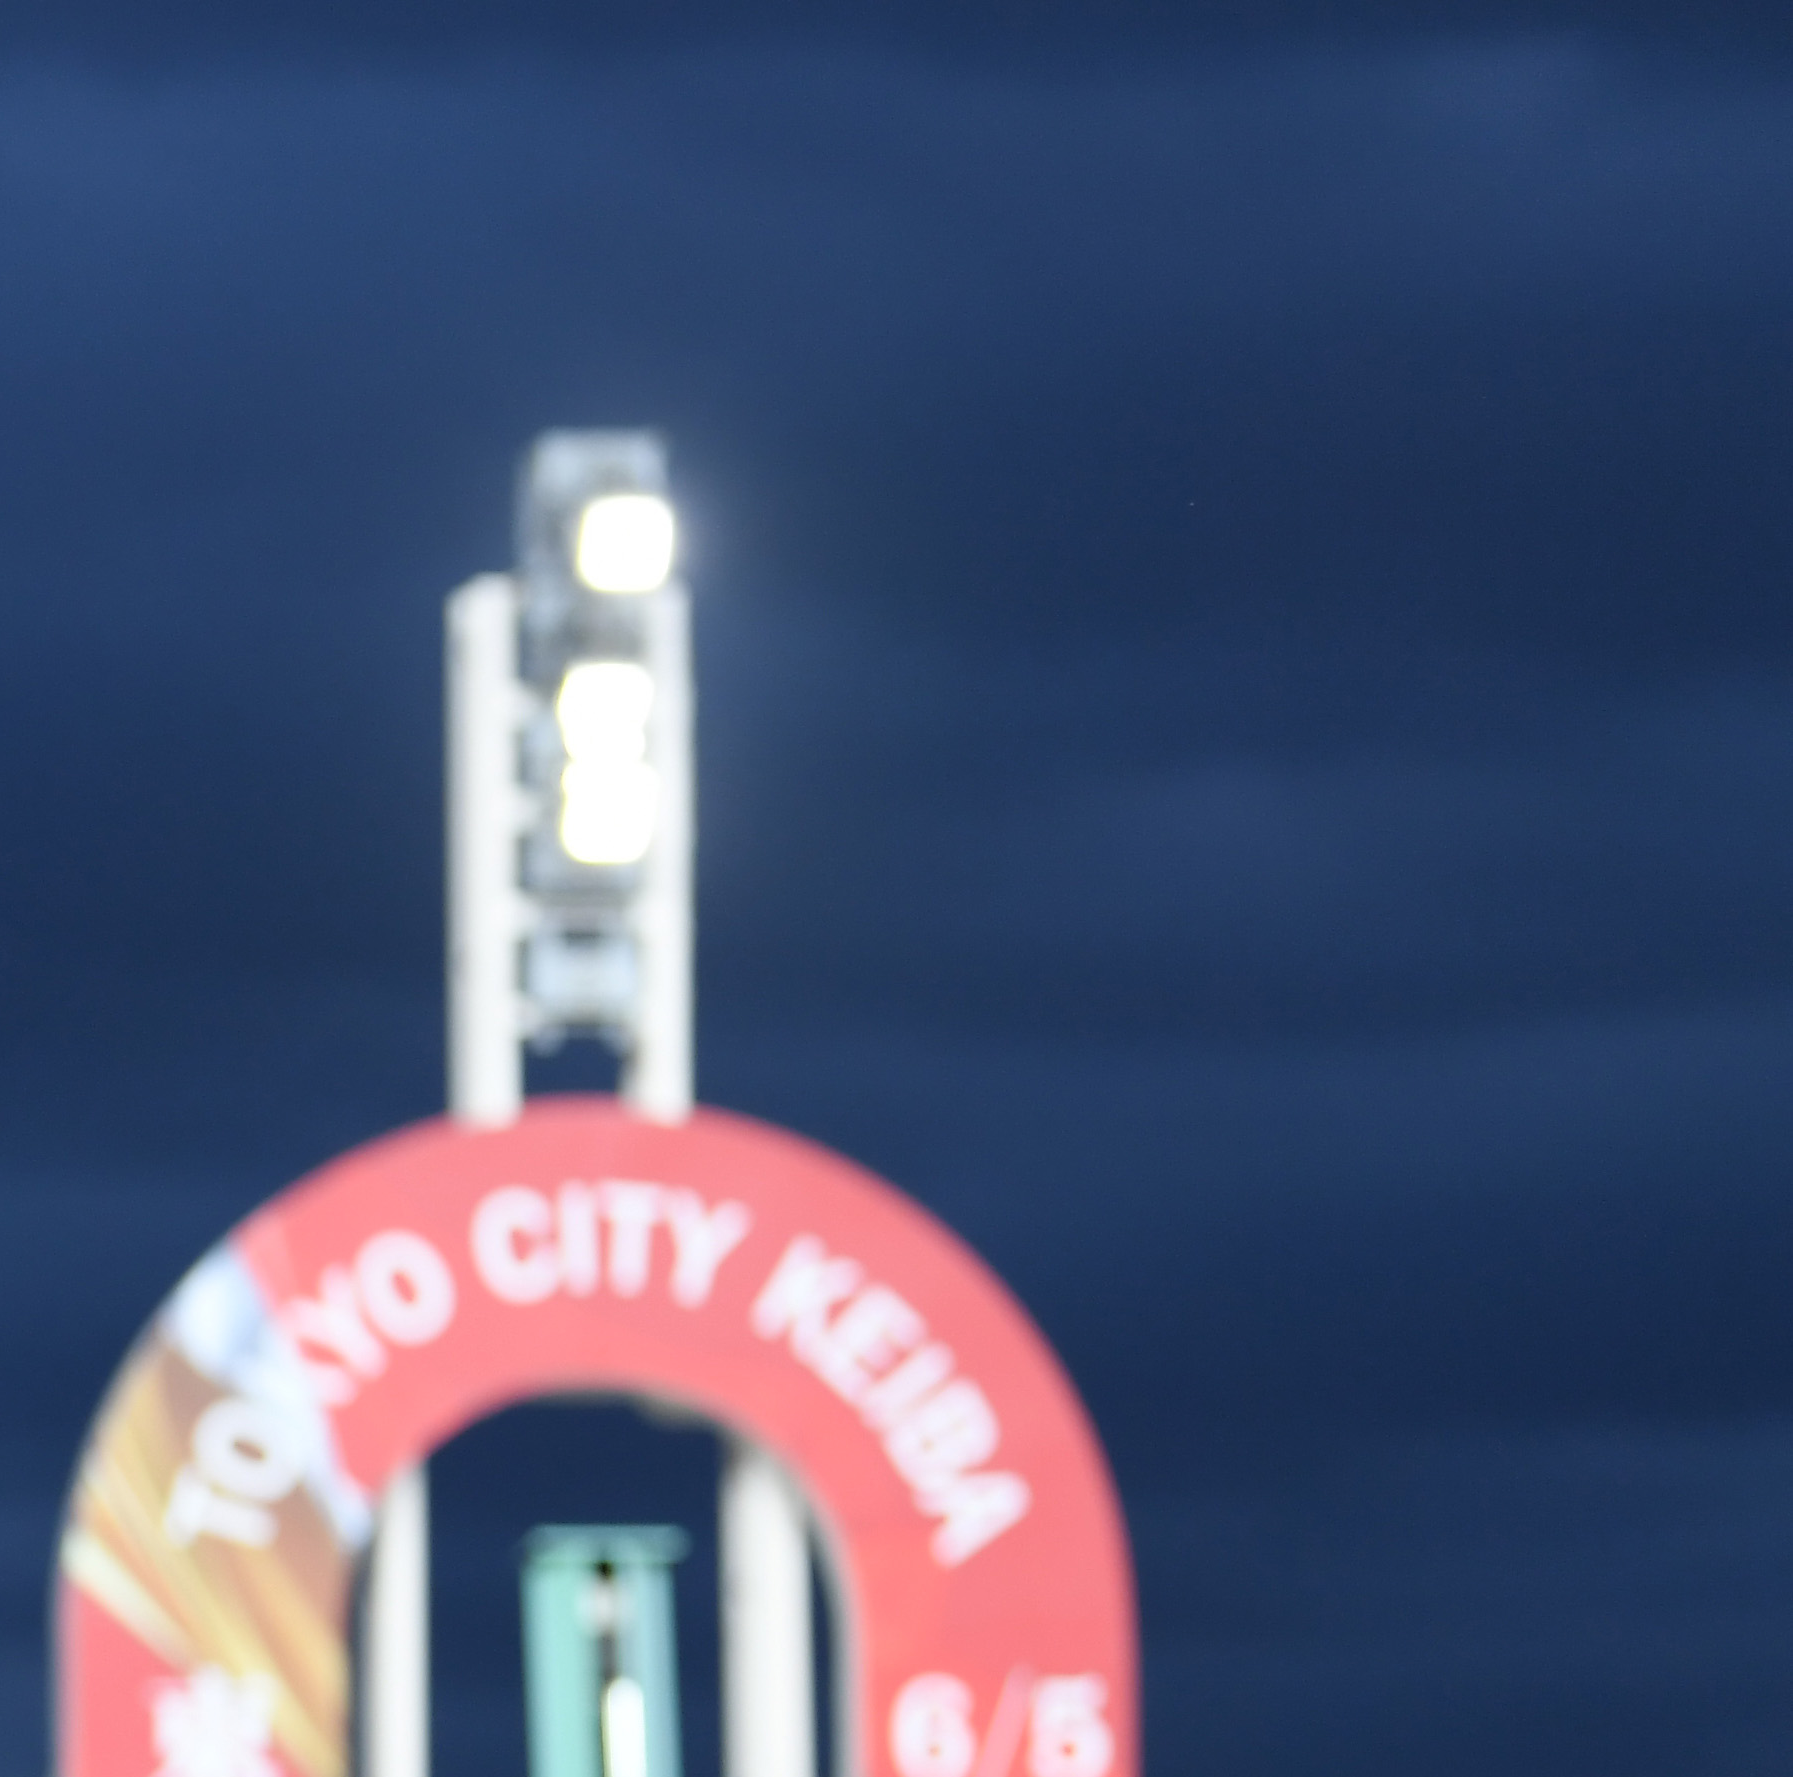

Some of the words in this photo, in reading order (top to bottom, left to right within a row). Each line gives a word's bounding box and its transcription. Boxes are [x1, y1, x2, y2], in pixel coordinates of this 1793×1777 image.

[164, 1229, 455, 1548] TOKYO
[470, 1180, 753, 1308] CITY
[750, 1234, 1030, 1566] KEIBA
